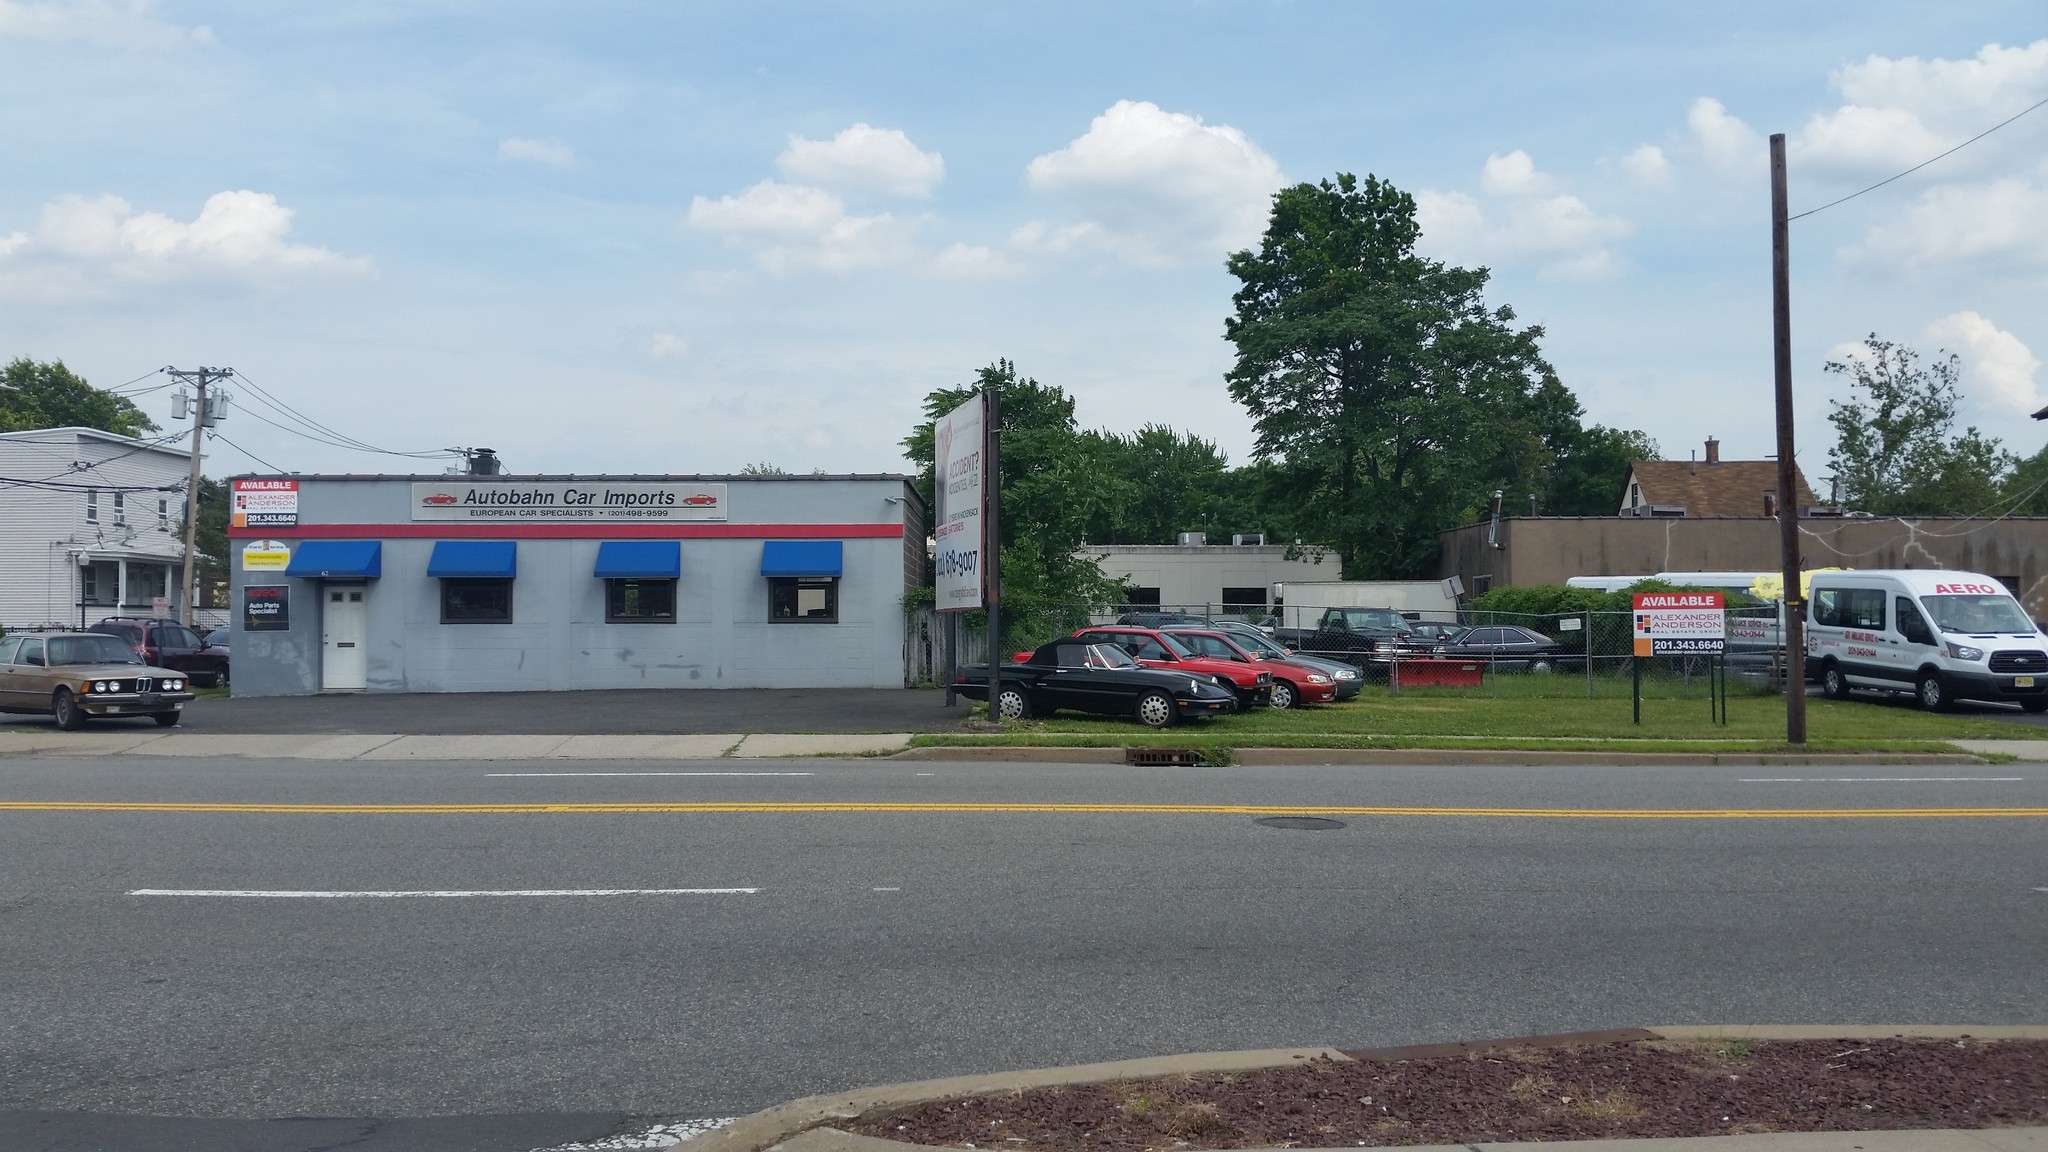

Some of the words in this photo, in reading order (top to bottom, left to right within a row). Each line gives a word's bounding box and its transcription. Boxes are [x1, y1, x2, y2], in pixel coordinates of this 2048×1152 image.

[949, 451, 979, 479] ACCIDENT?
[464, 489, 555, 505] Autobahn
[563, 489, 597, 505] Car
[603, 489, 675, 508] Imports
[470, 509, 516, 517] EUROPEAN
[519, 509, 537, 517] CAR
[540, 509, 594, 517] SPECIALISTS
[1936, 584, 1996, 595] AERO
[1641, 596, 1715, 607] AVAILABLE
[1652, 621, 1722, 629] ANDERSON
[1654, 640, 1724, 650] 201.343.6640
